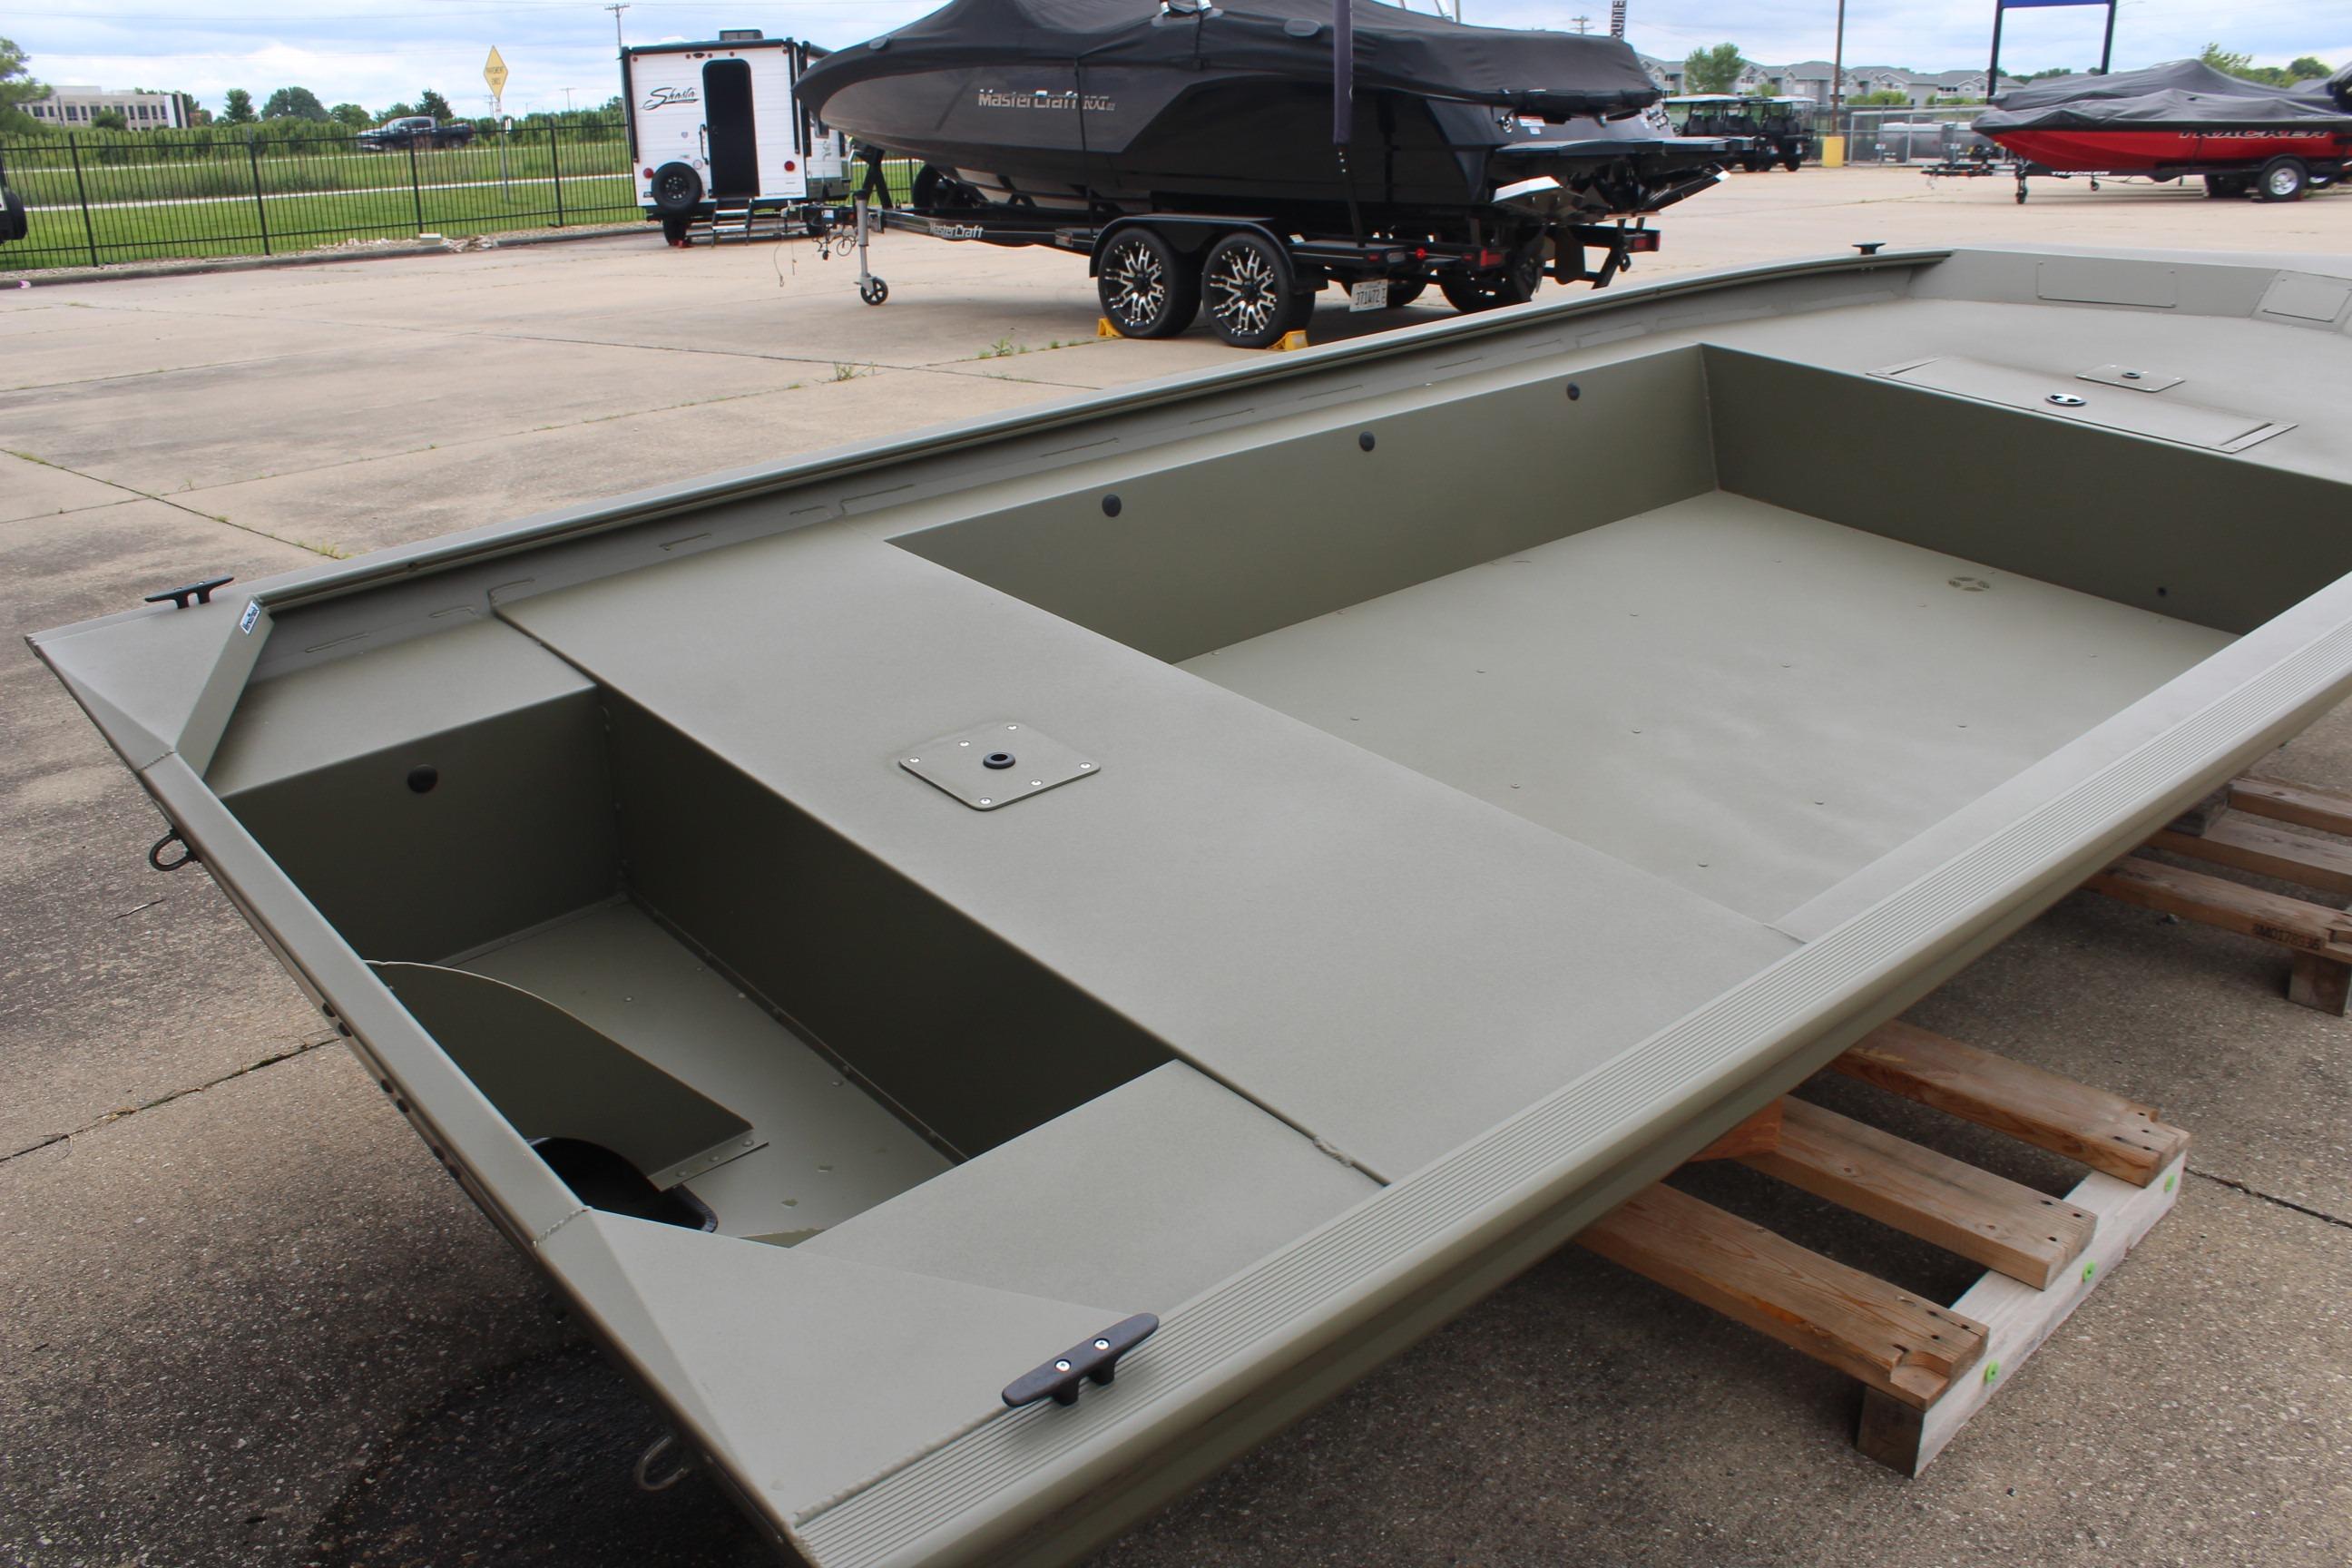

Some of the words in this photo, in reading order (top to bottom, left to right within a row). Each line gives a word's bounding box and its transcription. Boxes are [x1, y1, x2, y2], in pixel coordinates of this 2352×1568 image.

[640, 87, 699, 111] Shasta
[978, 89, 1079, 110] MasterCraft
[929, 221, 984, 239] MasterCraft
